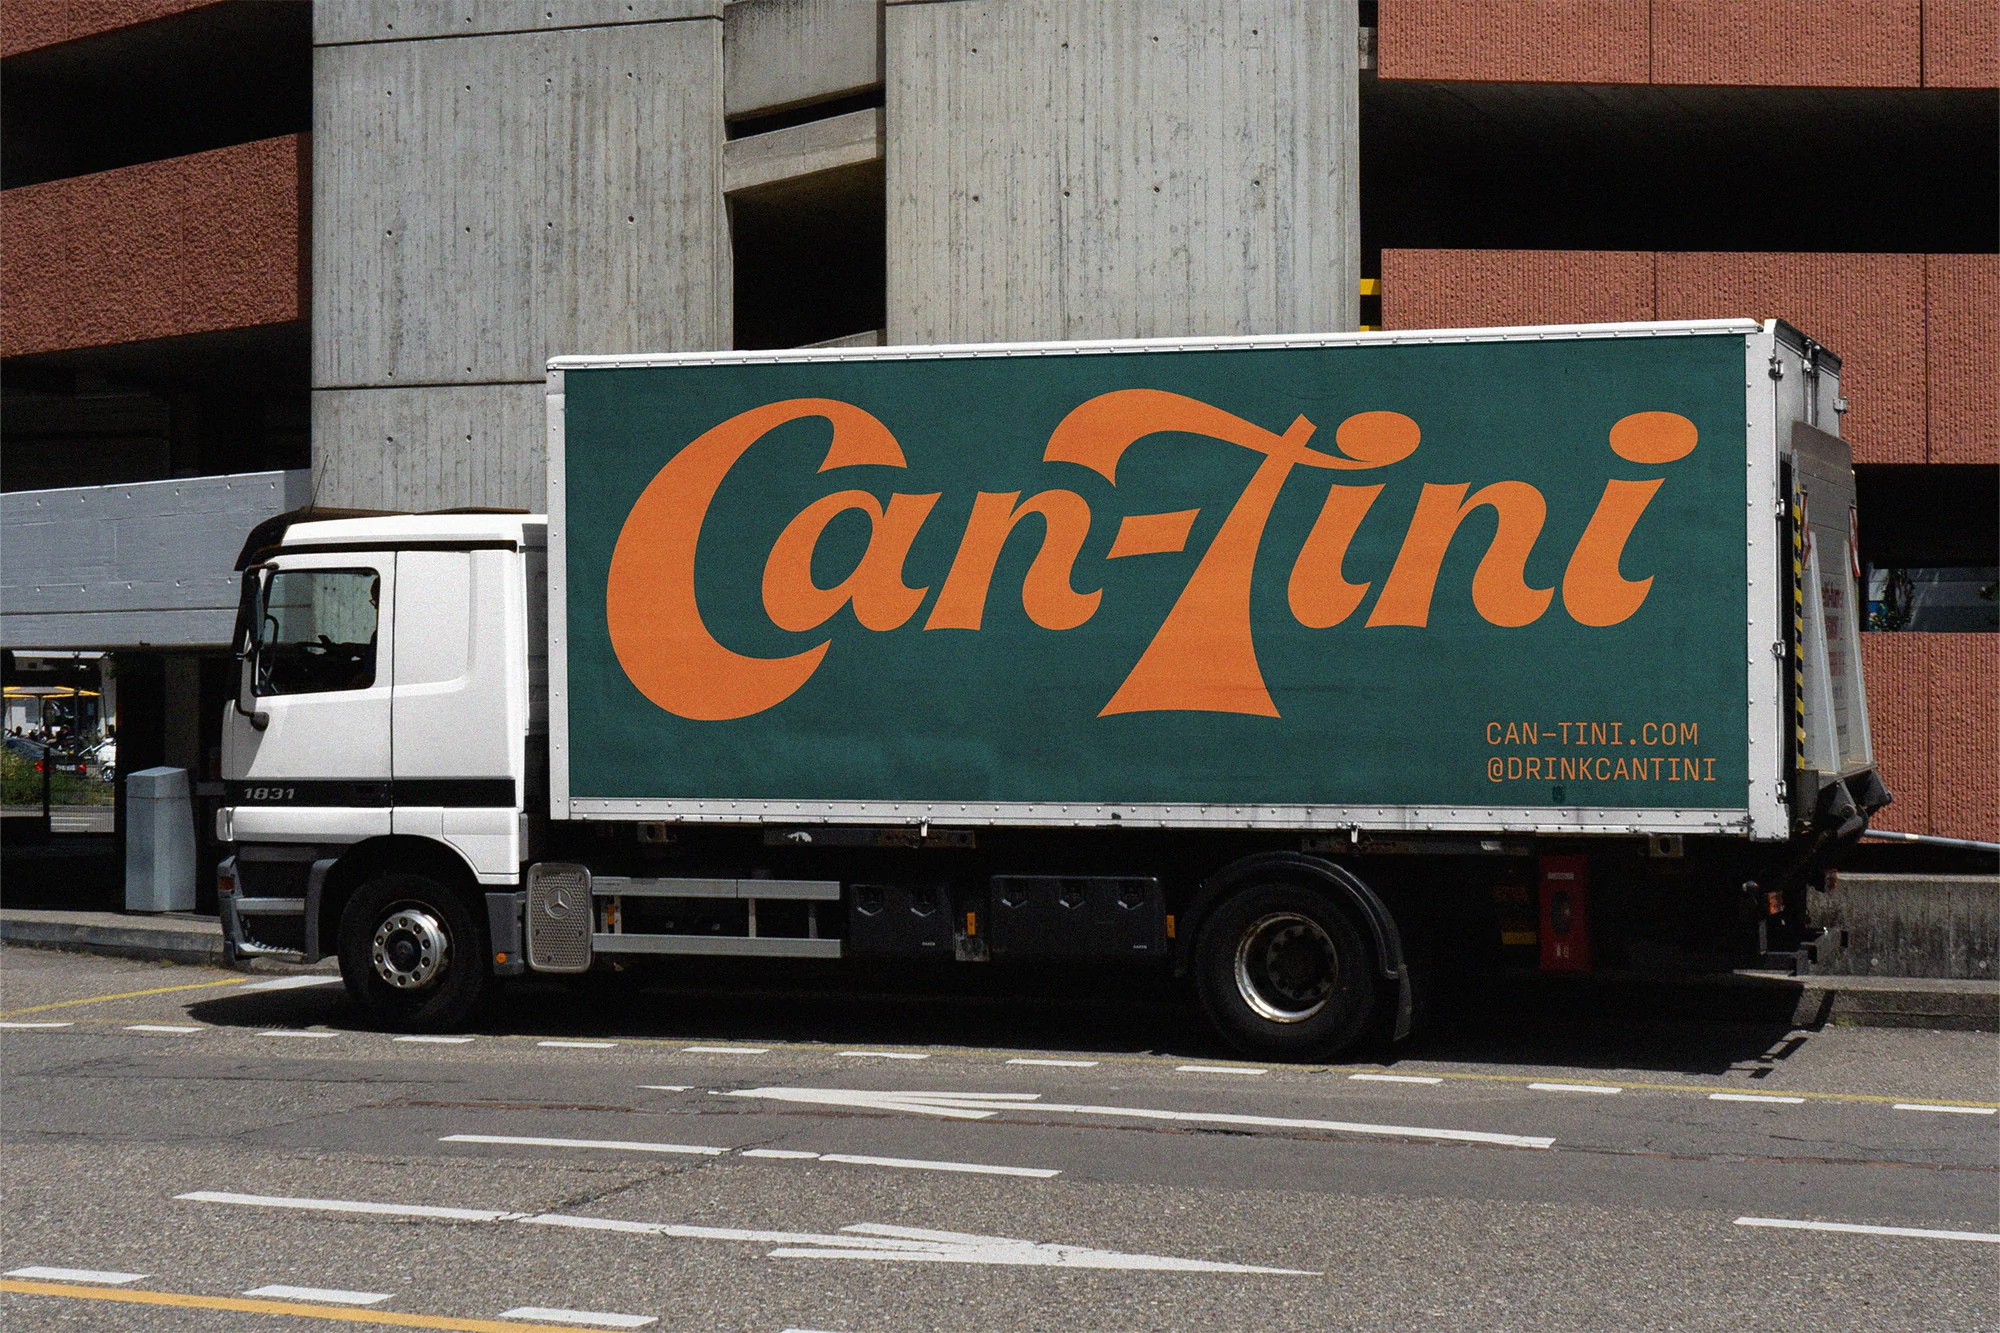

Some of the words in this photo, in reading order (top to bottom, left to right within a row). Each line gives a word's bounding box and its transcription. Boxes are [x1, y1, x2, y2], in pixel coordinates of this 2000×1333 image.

[606, 388, 1698, 721] Can-Tini
[1486, 722, 1698, 745] CAN-TINI.COM
[1487, 757, 1716, 782] @DRINKCANTINI
[244, 787, 295, 800] 1831
